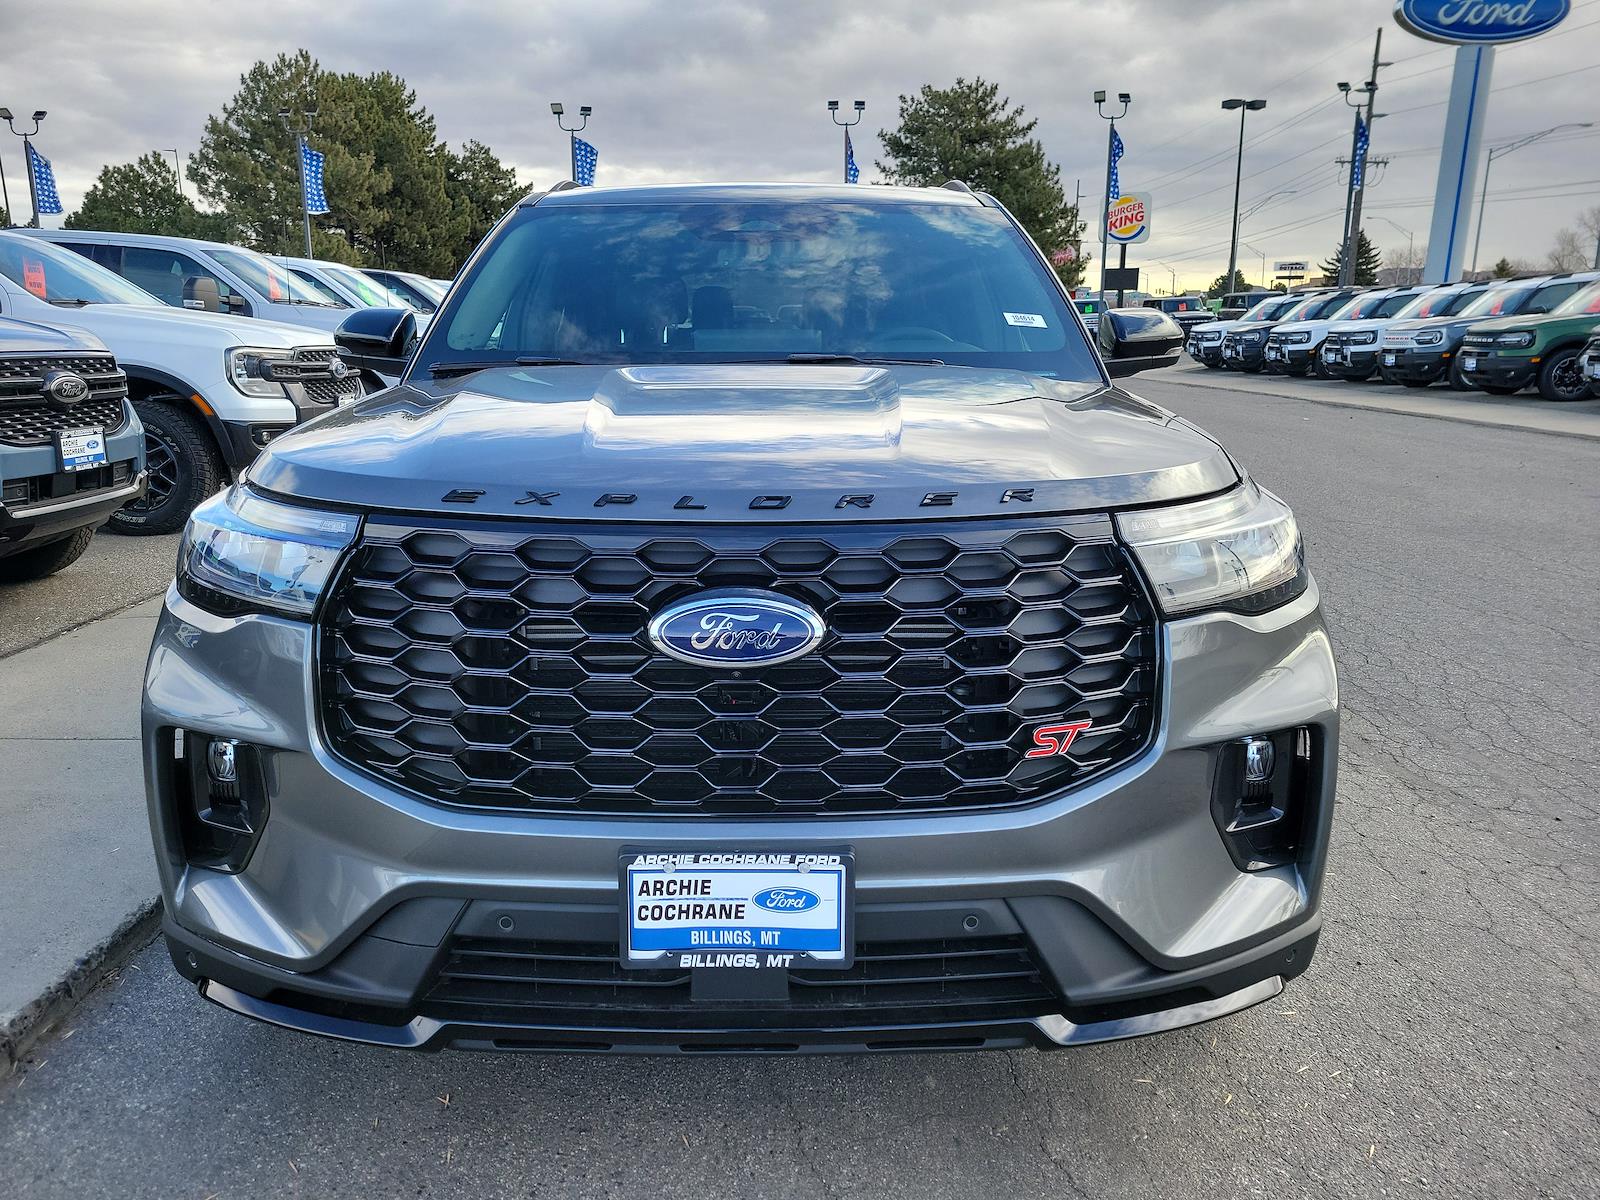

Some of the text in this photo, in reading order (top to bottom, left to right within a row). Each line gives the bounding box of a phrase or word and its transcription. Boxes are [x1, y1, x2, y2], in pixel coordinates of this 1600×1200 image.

[1438, 0, 1535, 26] Ford
[1108, 202, 1144, 220] BURGER
[1108, 211, 1145, 232] KING
[61, 381, 82, 397] Ford
[441, 488, 1035, 510] EXPLORER
[691, 612, 784, 650] Ford
[1024, 718, 1093, 759] ST
[633, 854, 841, 866] ARCHIE COCHRANE FORD
[638, 879, 712, 897] ARCHIE
[766, 889, 806, 909] Ford
[637, 904, 746, 921] COCHRANE
[690, 930, 781, 947] BILLINGS, MT
[679, 954, 794, 970] BILLINGS, MT
